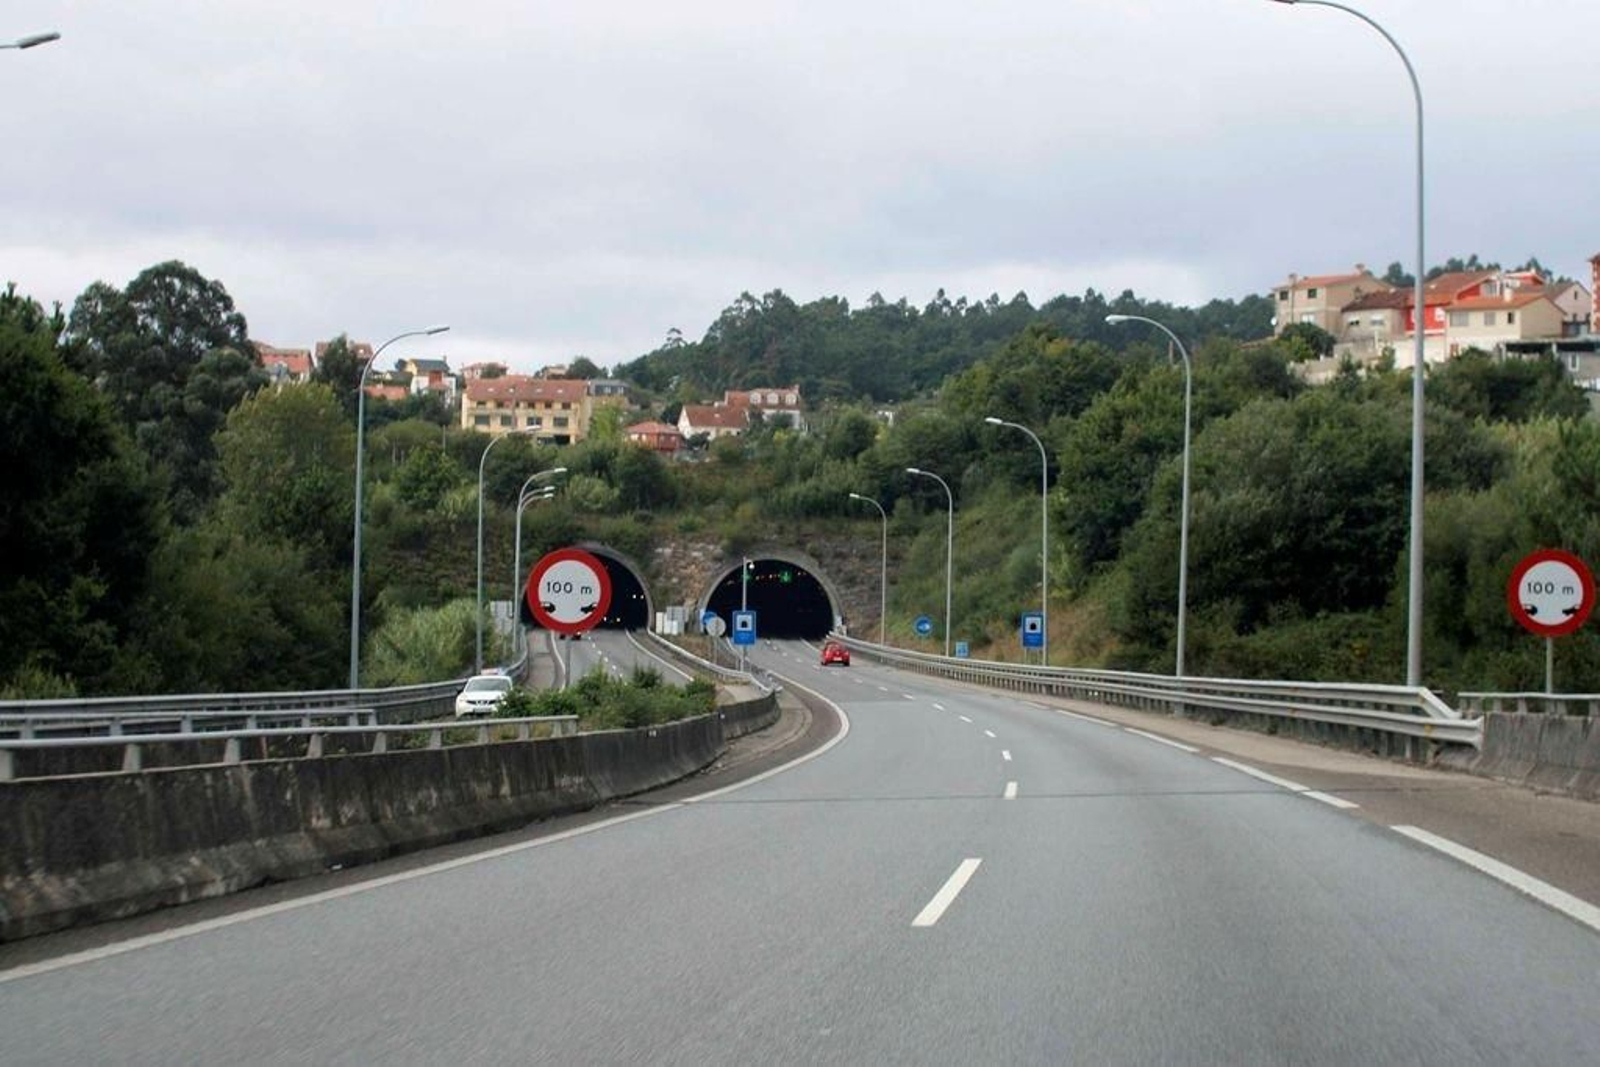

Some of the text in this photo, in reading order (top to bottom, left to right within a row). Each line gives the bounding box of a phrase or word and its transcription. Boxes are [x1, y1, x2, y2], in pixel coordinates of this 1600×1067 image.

[546, 581, 592, 595] 100 m
[1527, 582, 1574, 595] 100 m
